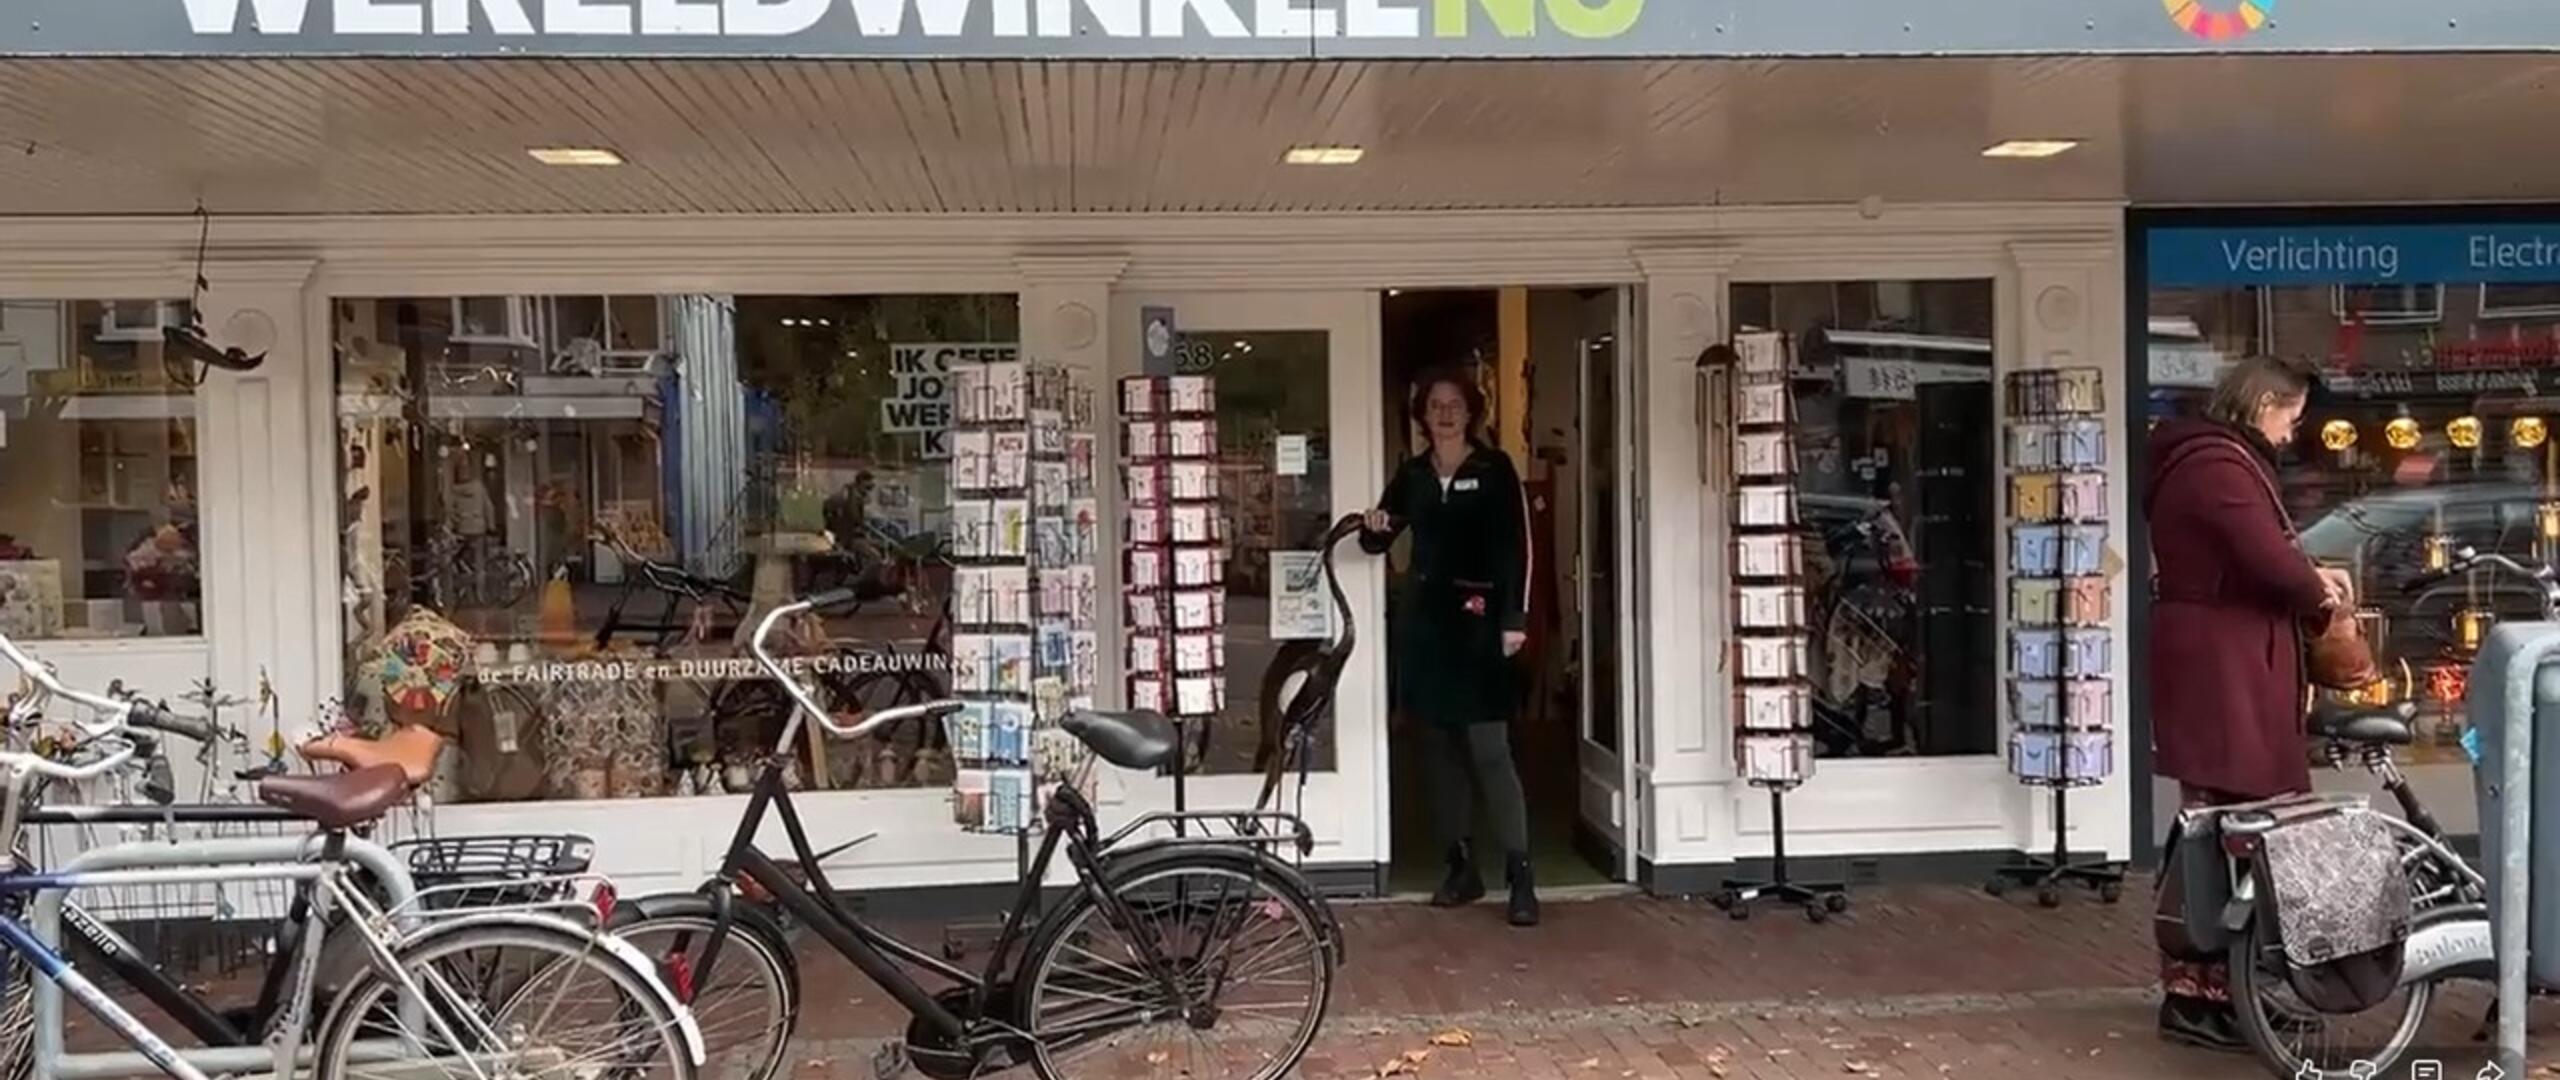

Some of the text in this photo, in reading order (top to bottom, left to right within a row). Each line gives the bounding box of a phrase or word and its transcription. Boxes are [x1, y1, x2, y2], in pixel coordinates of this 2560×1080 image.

[2221, 234, 2560, 277] Verlichting Electr
[895, 349, 926, 373] IK
[1174, 342, 1213, 369] 58
[903, 377, 950, 400] JO
[478, 666, 502, 684] de
[513, 661, 636, 682] FAIRTRADE
[646, 664, 670, 679] en
[813, 652, 948, 674] CADEAUWIN
[60, 906, 117, 956] azelle
